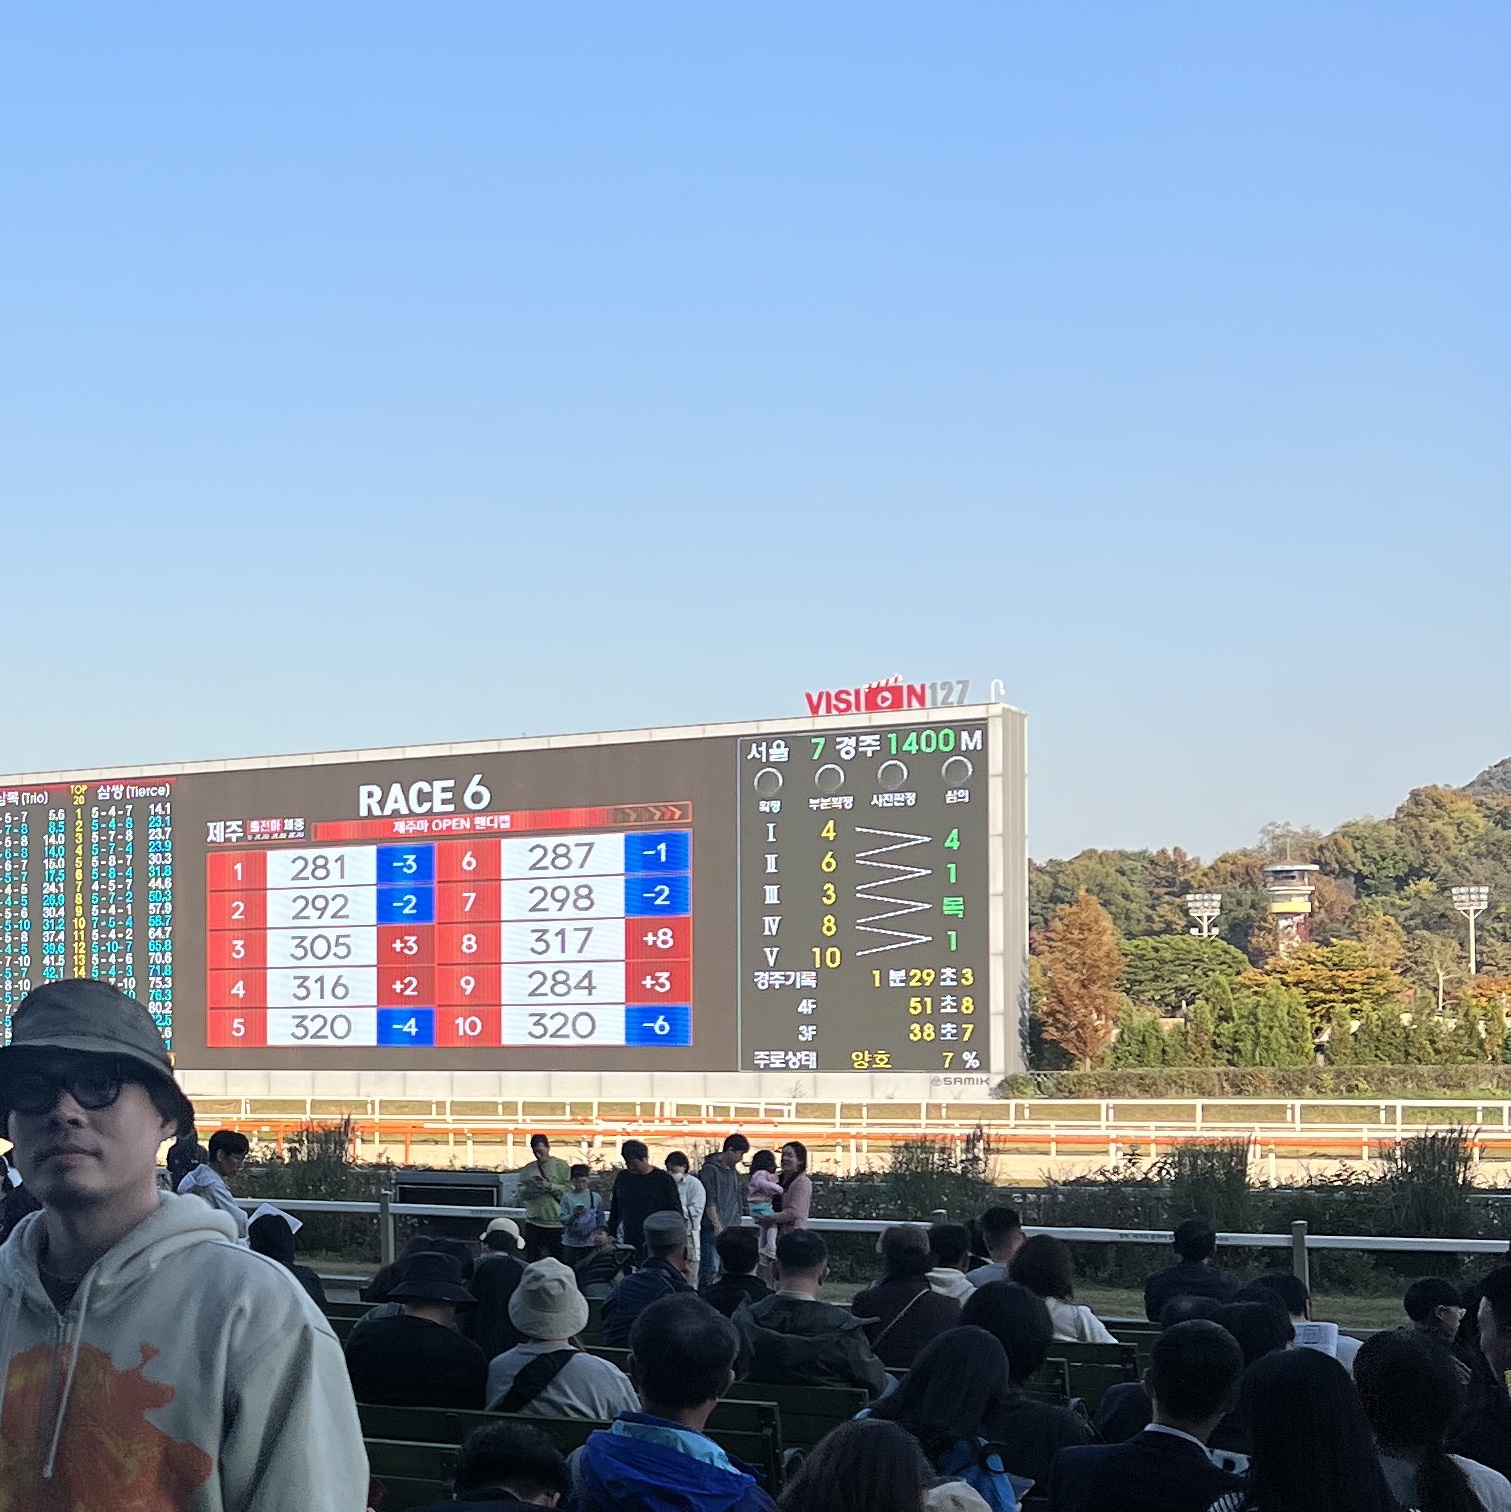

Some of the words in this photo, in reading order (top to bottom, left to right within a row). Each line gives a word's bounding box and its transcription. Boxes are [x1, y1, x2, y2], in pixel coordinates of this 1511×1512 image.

[747, 740, 790, 762] 서울
[810, 737, 826, 759] 7
[836, 734, 881, 759] 경주
[888, 728, 956, 756] 1400
[961, 729, 983, 751] M
[360, 780, 454, 816] RACE
[464, 774, 491, 810] 6
[871, 792, 916, 807] 사진판정
[946, 788, 970, 803] 심의
[206, 820, 244, 844] 제주
[432, 818, 470, 831] OPEN
[821, 819, 836, 840] 4
[945, 828, 960, 850] 4
[234, 863, 241, 880] 1
[291, 854, 344, 881] 281
[393, 855, 417, 873] -3
[462, 851, 476, 870] 6
[528, 842, 594, 871] 287
[643, 843, 667, 862] -1
[822, 850, 837, 873] 6
[947, 863, 957, 884] 1
[231, 902, 244, 919] 2
[292, 894, 349, 920] 292
[393, 895, 417, 914] -2
[462, 893, 476, 911] 7
[529, 884, 594, 912] 298
[643, 885, 670, 904] -2
[821, 882, 837, 905] 3
[823, 914, 837, 937] 8
[232, 940, 244, 958] 3
[290, 934, 351, 960] 305
[392, 936, 418, 954] +3
[462, 934, 477, 953] 8
[530, 927, 593, 955] 317
[643, 927, 673, 948] +8
[948, 930, 957, 952] 1
[812, 948, 842, 969] 10
[231, 981, 245, 998] 4
[293, 975, 349, 1001] 316
[392, 977, 418, 995] +2
[460, 976, 475, 995] 9
[528, 970, 596, 997] 284
[642, 971, 670, 992] +3
[754, 972, 817, 989] 경주기록
[798, 998, 816, 1014] 4F
[232, 1018, 245, 1036] 5
[291, 1014, 351, 1040] 320
[393, 1018, 418, 1036] -4
[455, 1016, 481, 1035] 10
[528, 1012, 596, 1039] 320
[642, 1016, 670, 1034] -6
[799, 1025, 816, 1042] 3F
[754, 1050, 818, 1068] 주로상태
[850, 1050, 891, 1069] 양호
[943, 1053, 954, 1069] 7
[943, 1077, 989, 1085] SAMIK
